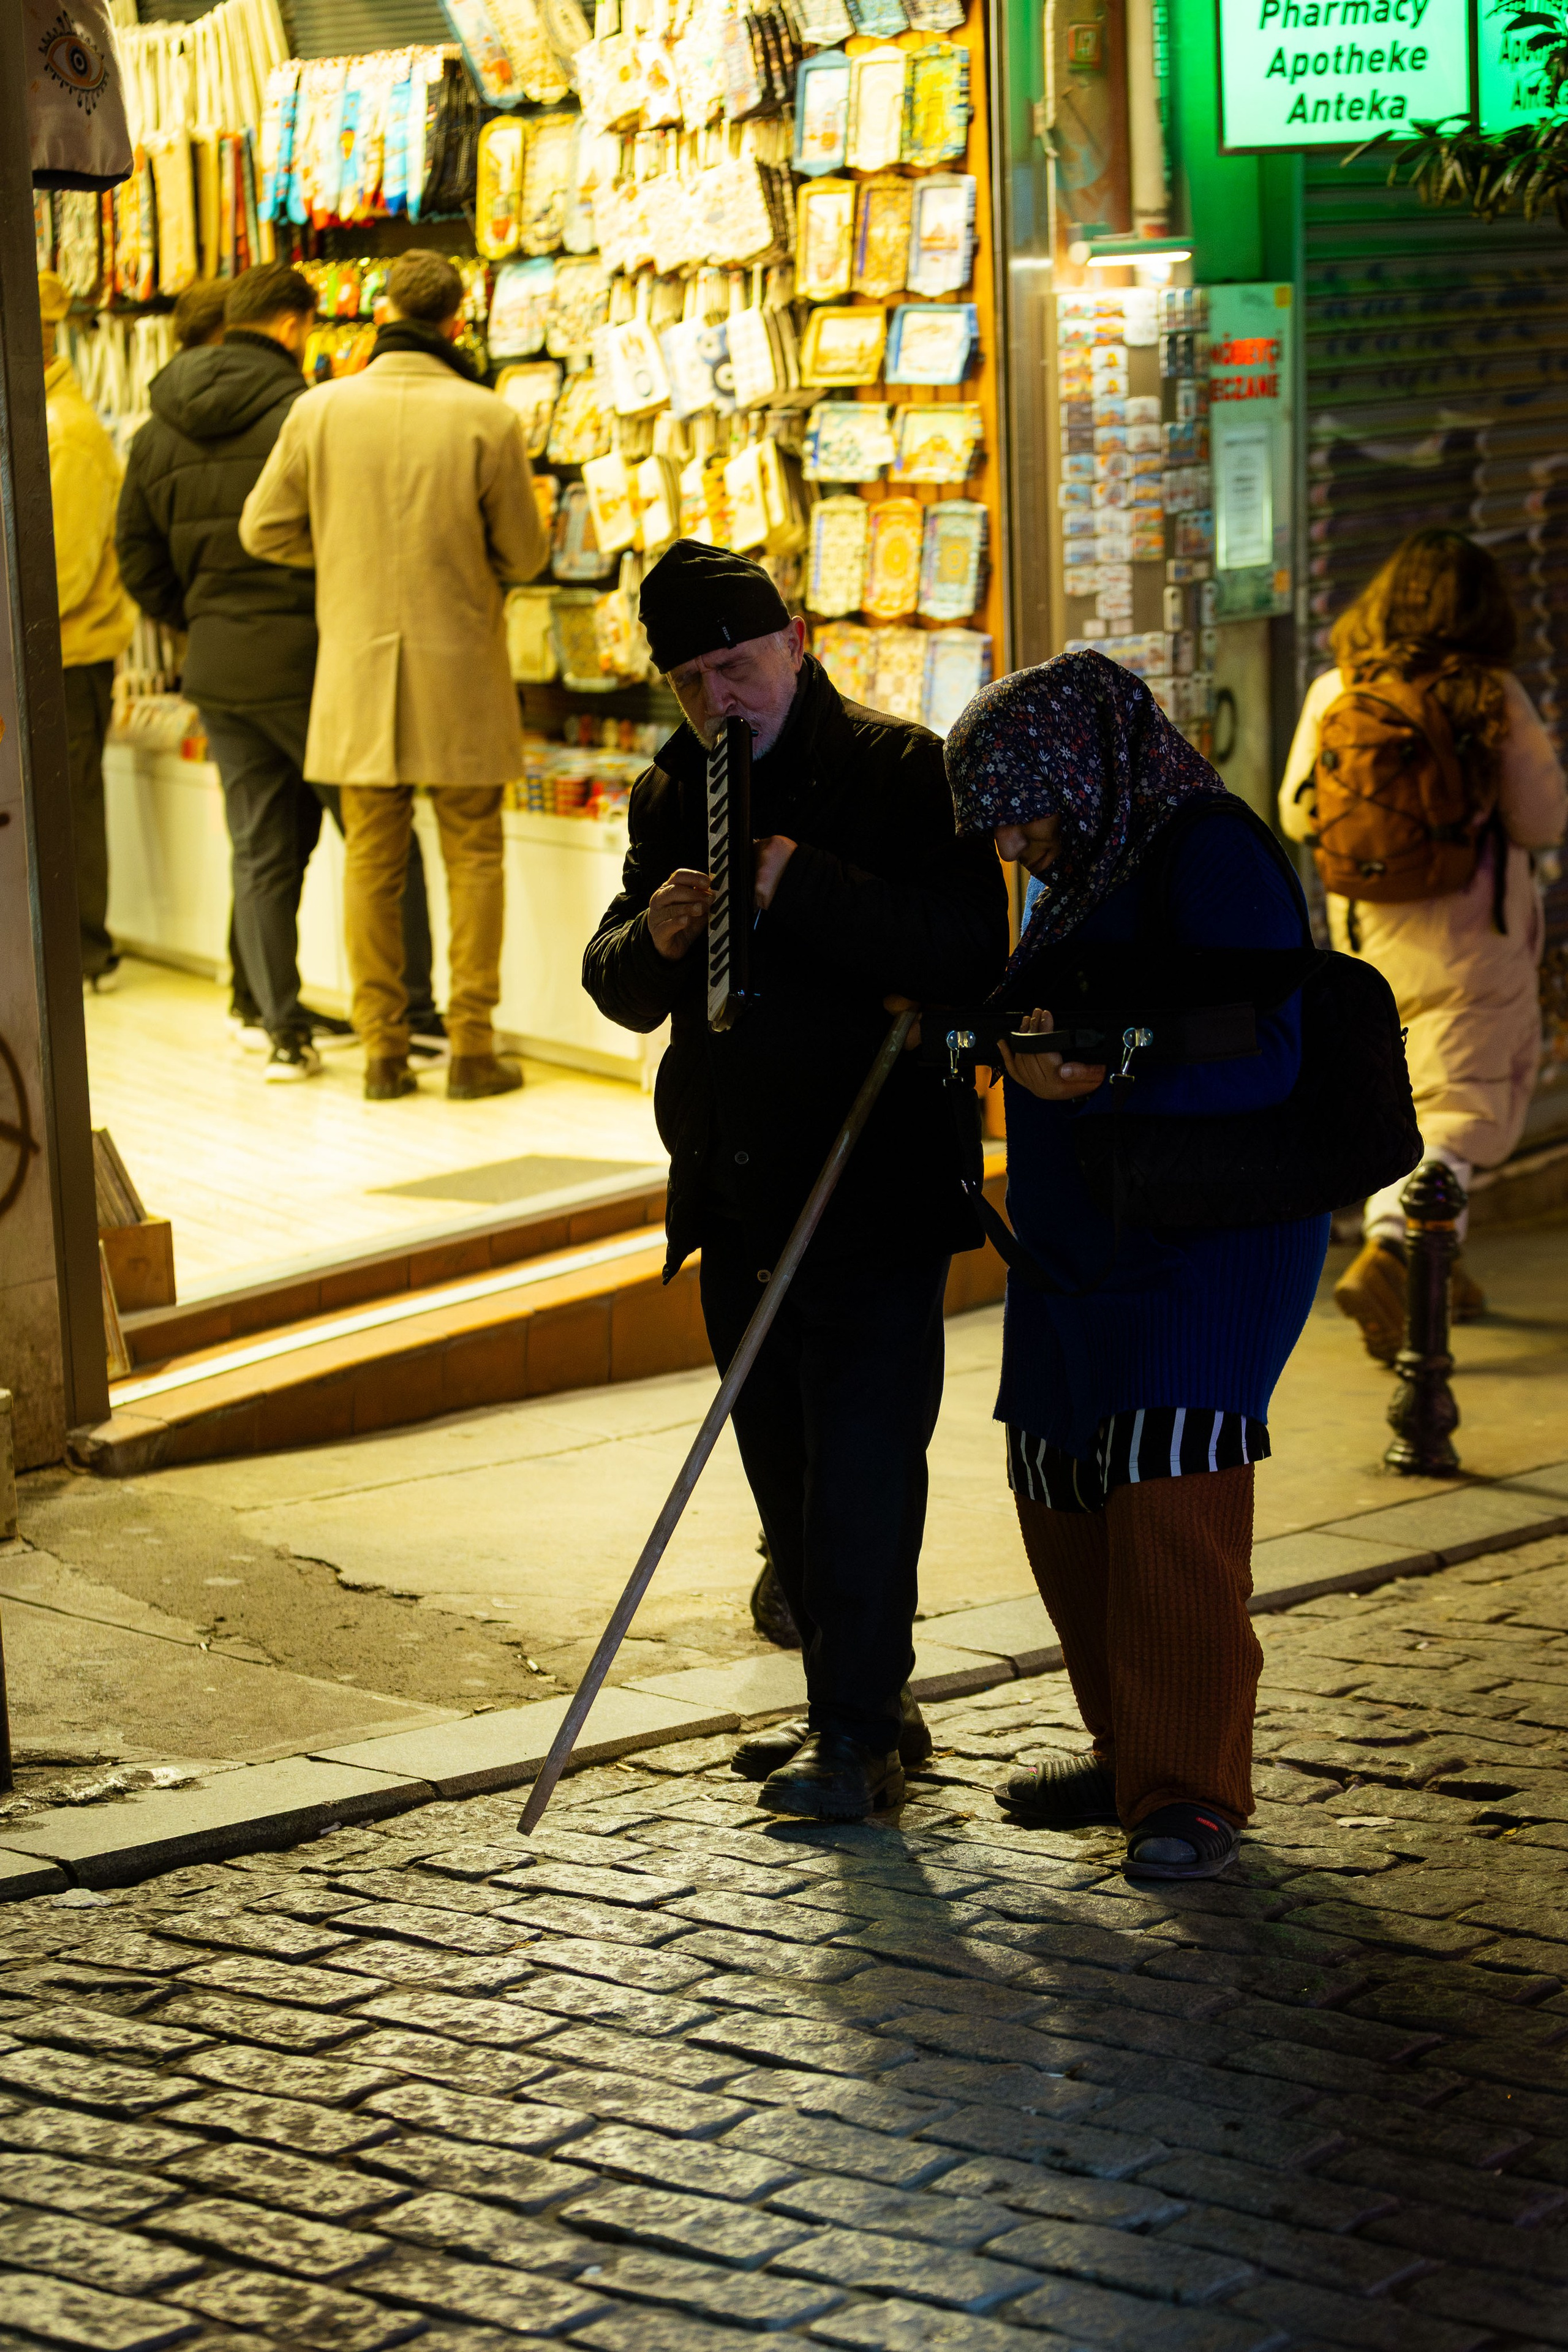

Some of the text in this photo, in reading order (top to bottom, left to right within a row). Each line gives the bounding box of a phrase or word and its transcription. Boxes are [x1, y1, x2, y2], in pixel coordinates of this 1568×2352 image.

[1259, 0, 1428, 29] Pharmacy
[1264, 40, 1428, 85] Apotheke
[1286, 89, 1407, 124] Anteka
